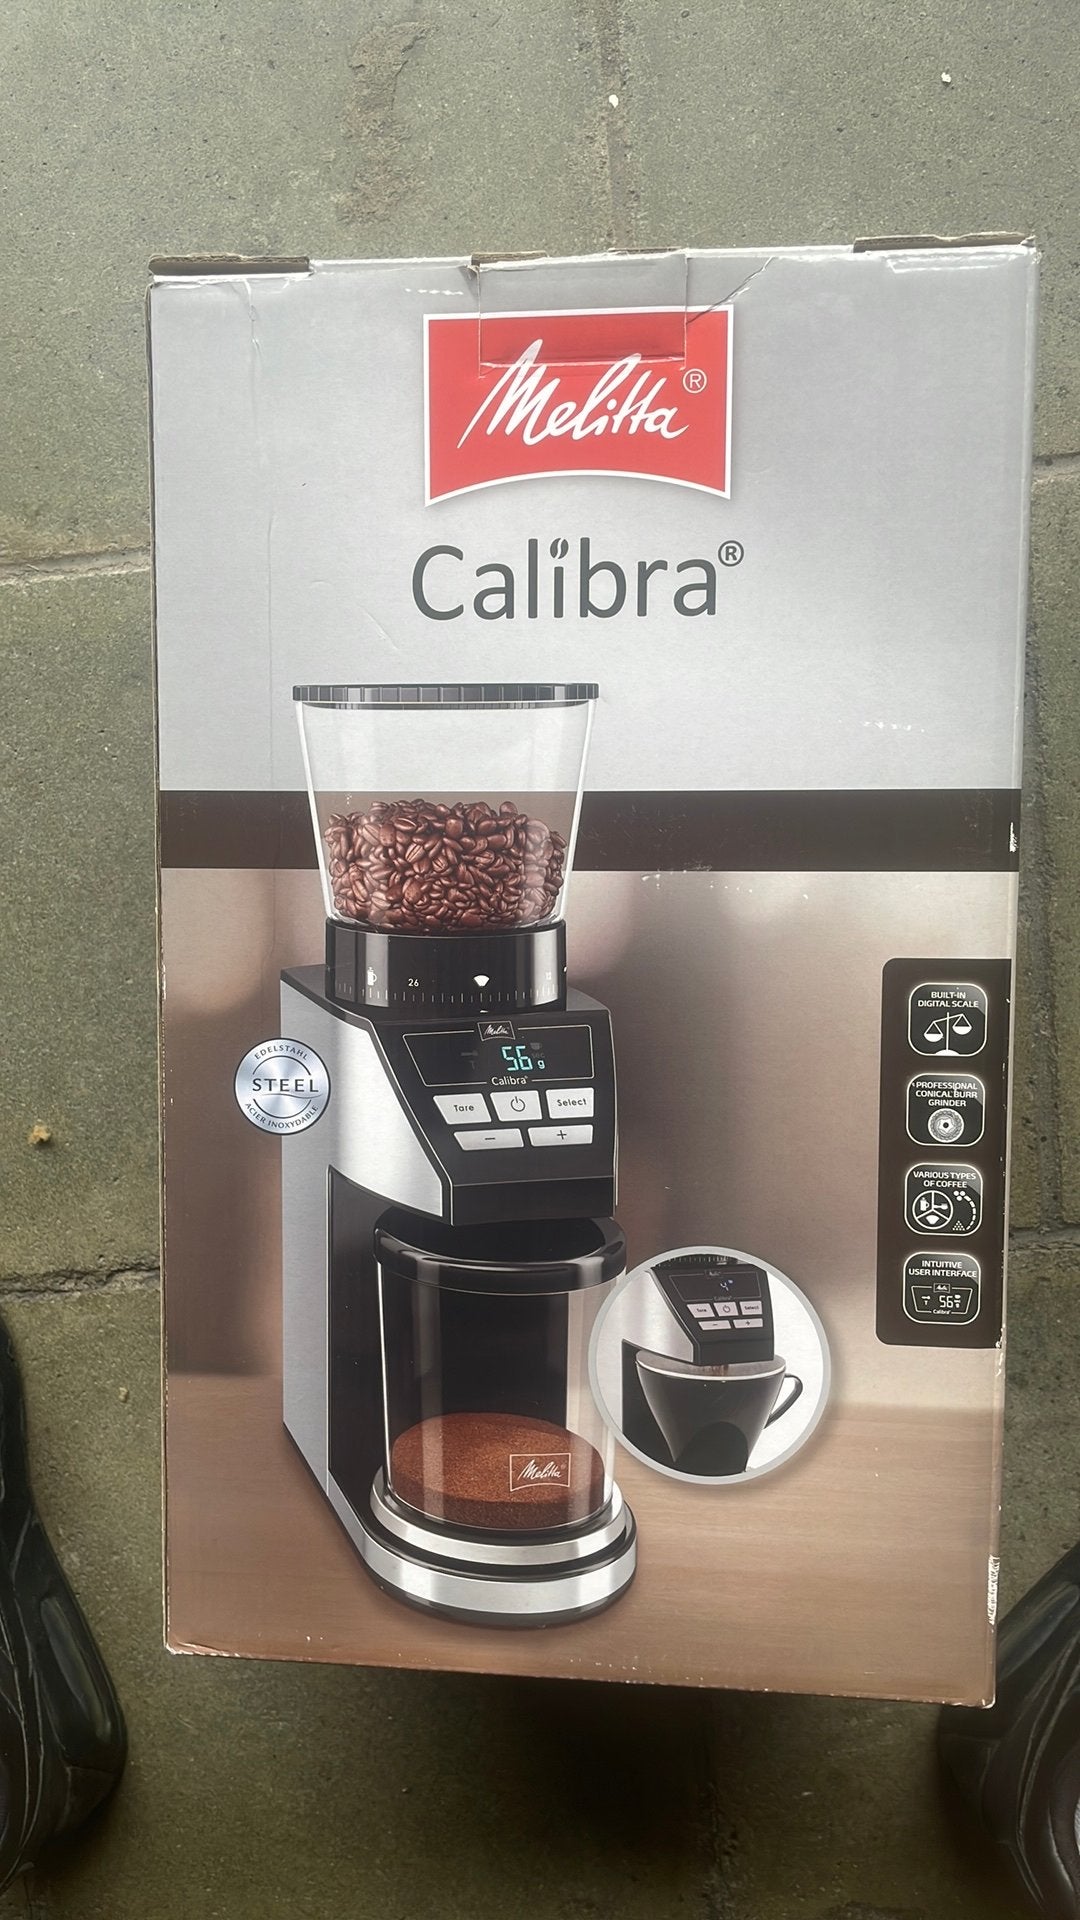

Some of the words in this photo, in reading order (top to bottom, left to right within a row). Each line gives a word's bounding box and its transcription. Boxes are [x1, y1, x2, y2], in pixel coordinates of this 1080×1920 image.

[408, 978, 420, 988] 26
[931, 991, 966, 999] BUILT-IN
[917, 1000, 950, 1008] DIGITAL
[951, 1000, 979, 1008] SCALE
[254, 1045, 308, 1060] EDELSTAHL
[501, 1045, 533, 1071] 56
[252, 1078, 319, 1093] STEEL
[916, 1081, 978, 1090] PROFESSIONAL
[915, 1090, 952, 1098] CONICAL
[953, 1090, 978, 1099] BURR
[557, 1098, 587, 1108] Select
[928, 1099, 967, 1107] GRINDER
[453, 1104, 475, 1113] Tare
[245, 1102, 266, 1124] ACIER
[267, 1105, 319, 1129] INOXYDABLE
[913, 1171, 949, 1179] VARIOUS
[950, 1172, 977, 1180] TYPES
[936, 1180, 968, 1189] COFFEE
[921, 1260, 962, 1269] INTUITIVE
[908, 1268, 931, 1276] USER
[932, 1269, 977, 1278] INTERFACE
[939, 1295, 953, 1308] 56
